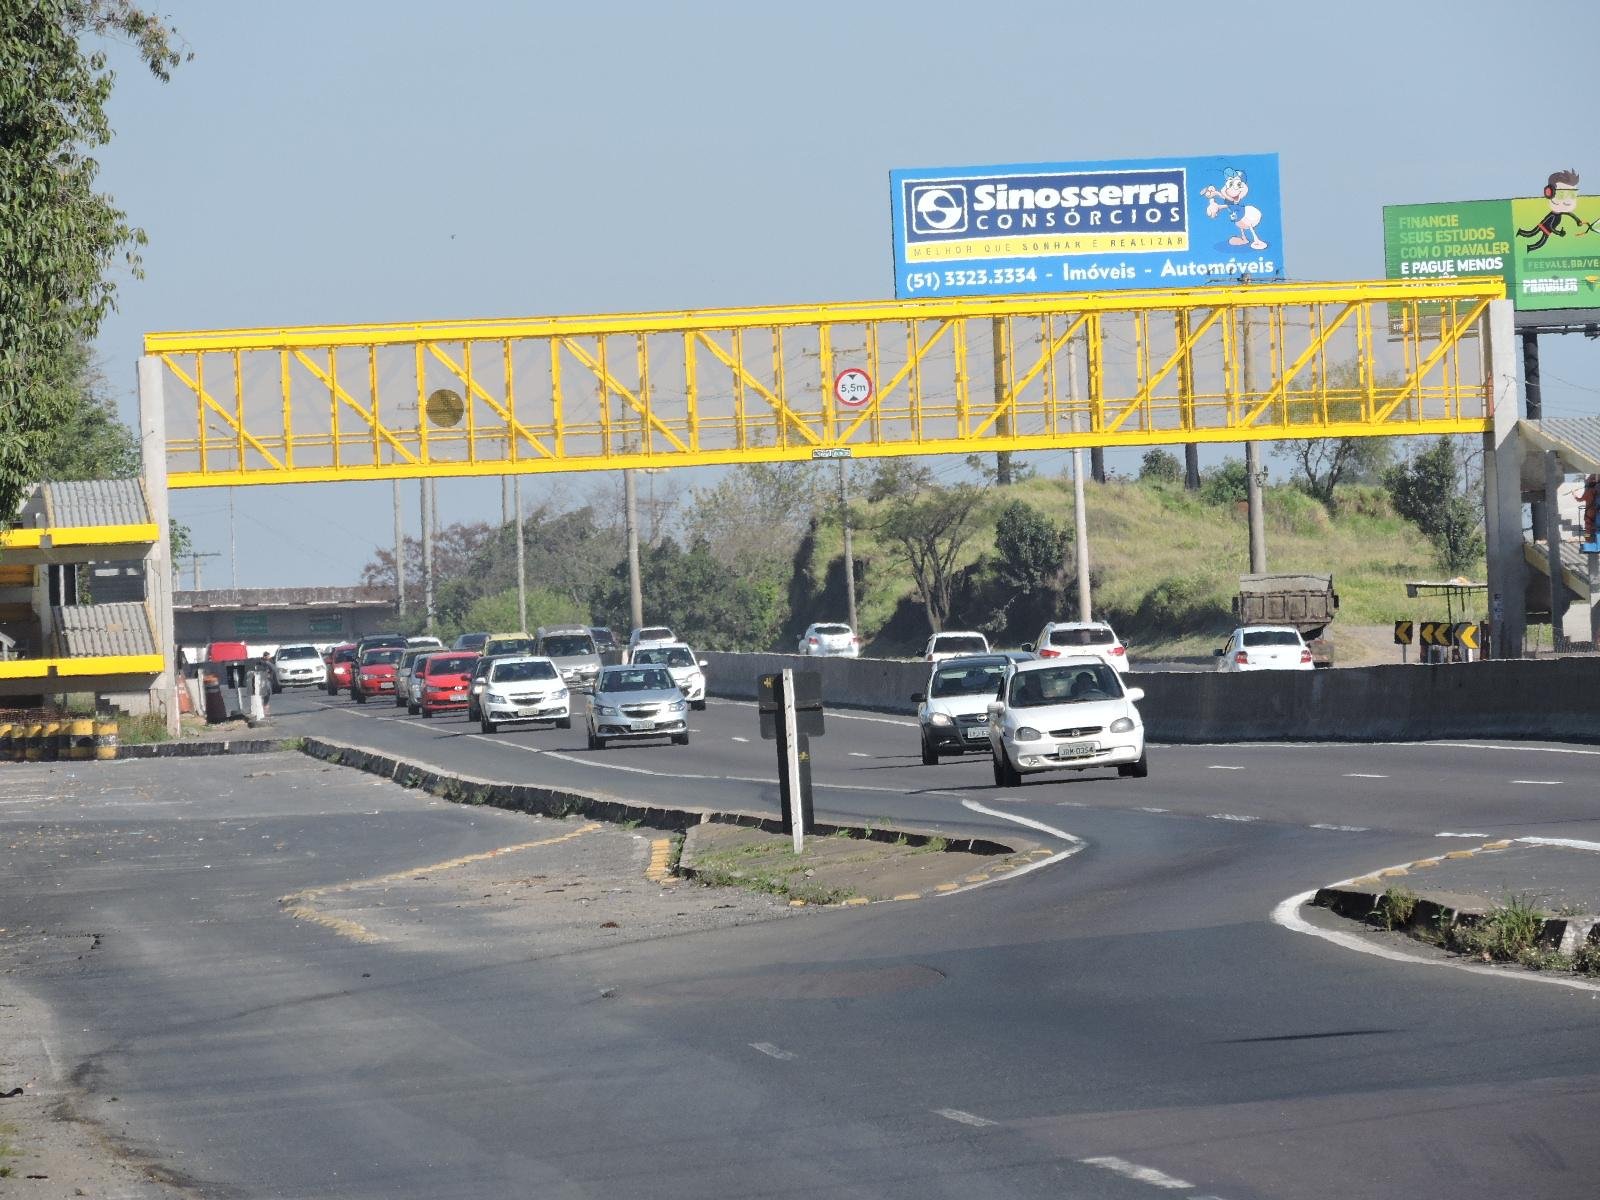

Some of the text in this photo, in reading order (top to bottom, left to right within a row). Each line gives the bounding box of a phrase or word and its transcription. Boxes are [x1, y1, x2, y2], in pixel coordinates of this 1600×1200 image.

[973, 183, 1179, 211] Sinosserra
[976, 207, 1180, 230] CONSÓRCIOS
[1399, 214, 1459, 229] FINANCIE
[1399, 227, 1495, 244] SEUS ESTUDOS
[913, 237, 1183, 256] MELHOR QUE SONHAR E REALIZAR
[1400, 241, 1510, 259] COM O PRAVALER
[906, 271, 941, 292] (51)
[944, 267, 1038, 286] 3323.3334
[1063, 259, 1136, 281] Imóveis
[1160, 256, 1274, 278] Automóveis
[1401, 256, 1504, 275] E PAGUE MENOS
[840, 383, 866, 394] 5,5m
